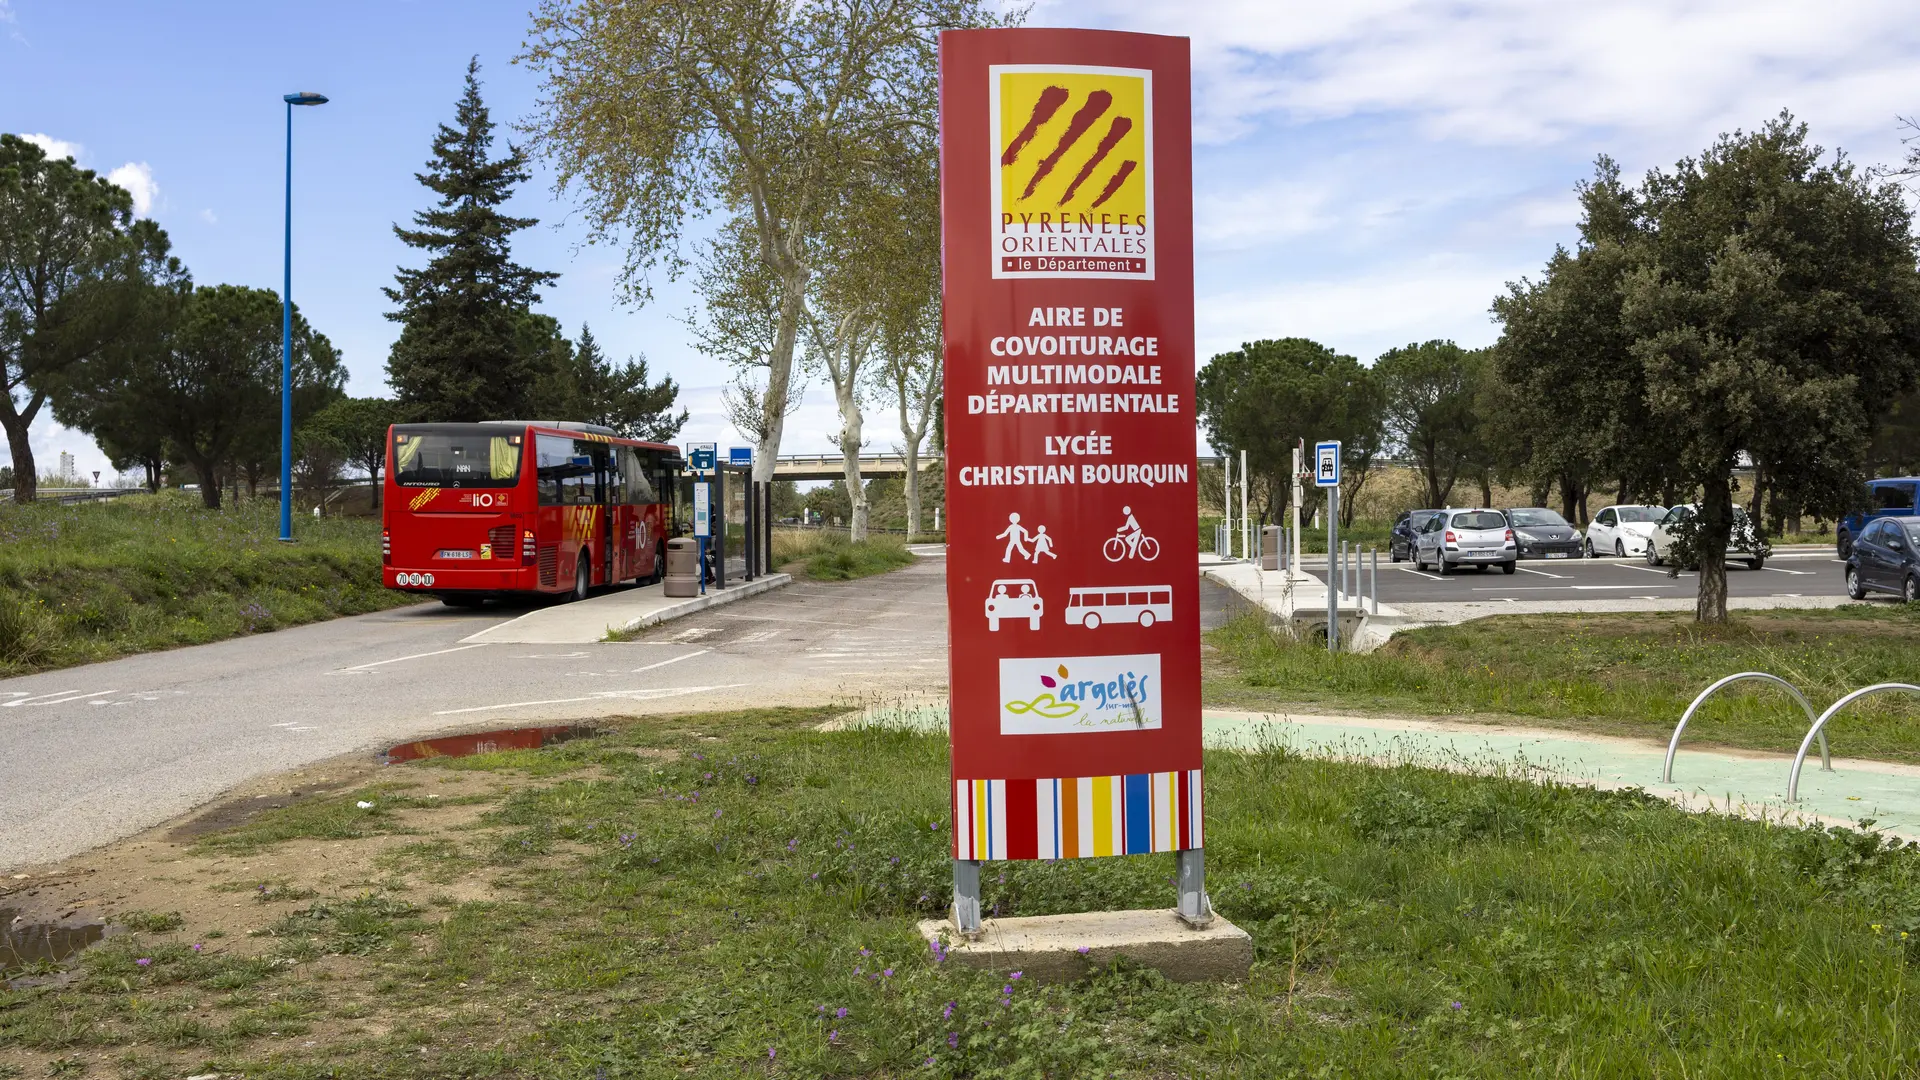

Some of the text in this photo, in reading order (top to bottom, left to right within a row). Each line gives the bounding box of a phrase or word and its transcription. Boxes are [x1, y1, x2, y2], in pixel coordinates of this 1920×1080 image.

[1001, 212, 1146, 235] PYRENEES
[1002, 236, 1146, 254] ORIENTALES
[1018, 257, 1131, 272] le Département
[1028, 307, 1123, 327] AIRE DE
[990, 336, 1158, 356] COVOITURAGE
[987, 365, 1162, 384] MULTIMODALE
[968, 389, 1179, 414] DÉPARTEMENTALE
[1045, 430, 1112, 455] LYCÉE
[959, 464, 1188, 488] CHRISTIAN BOURQUIN
[399, 574, 407, 585] 70
[411, 574, 419, 585] 90
[423, 574, 433, 585] 100
[1060, 671, 1148, 710] argelès
